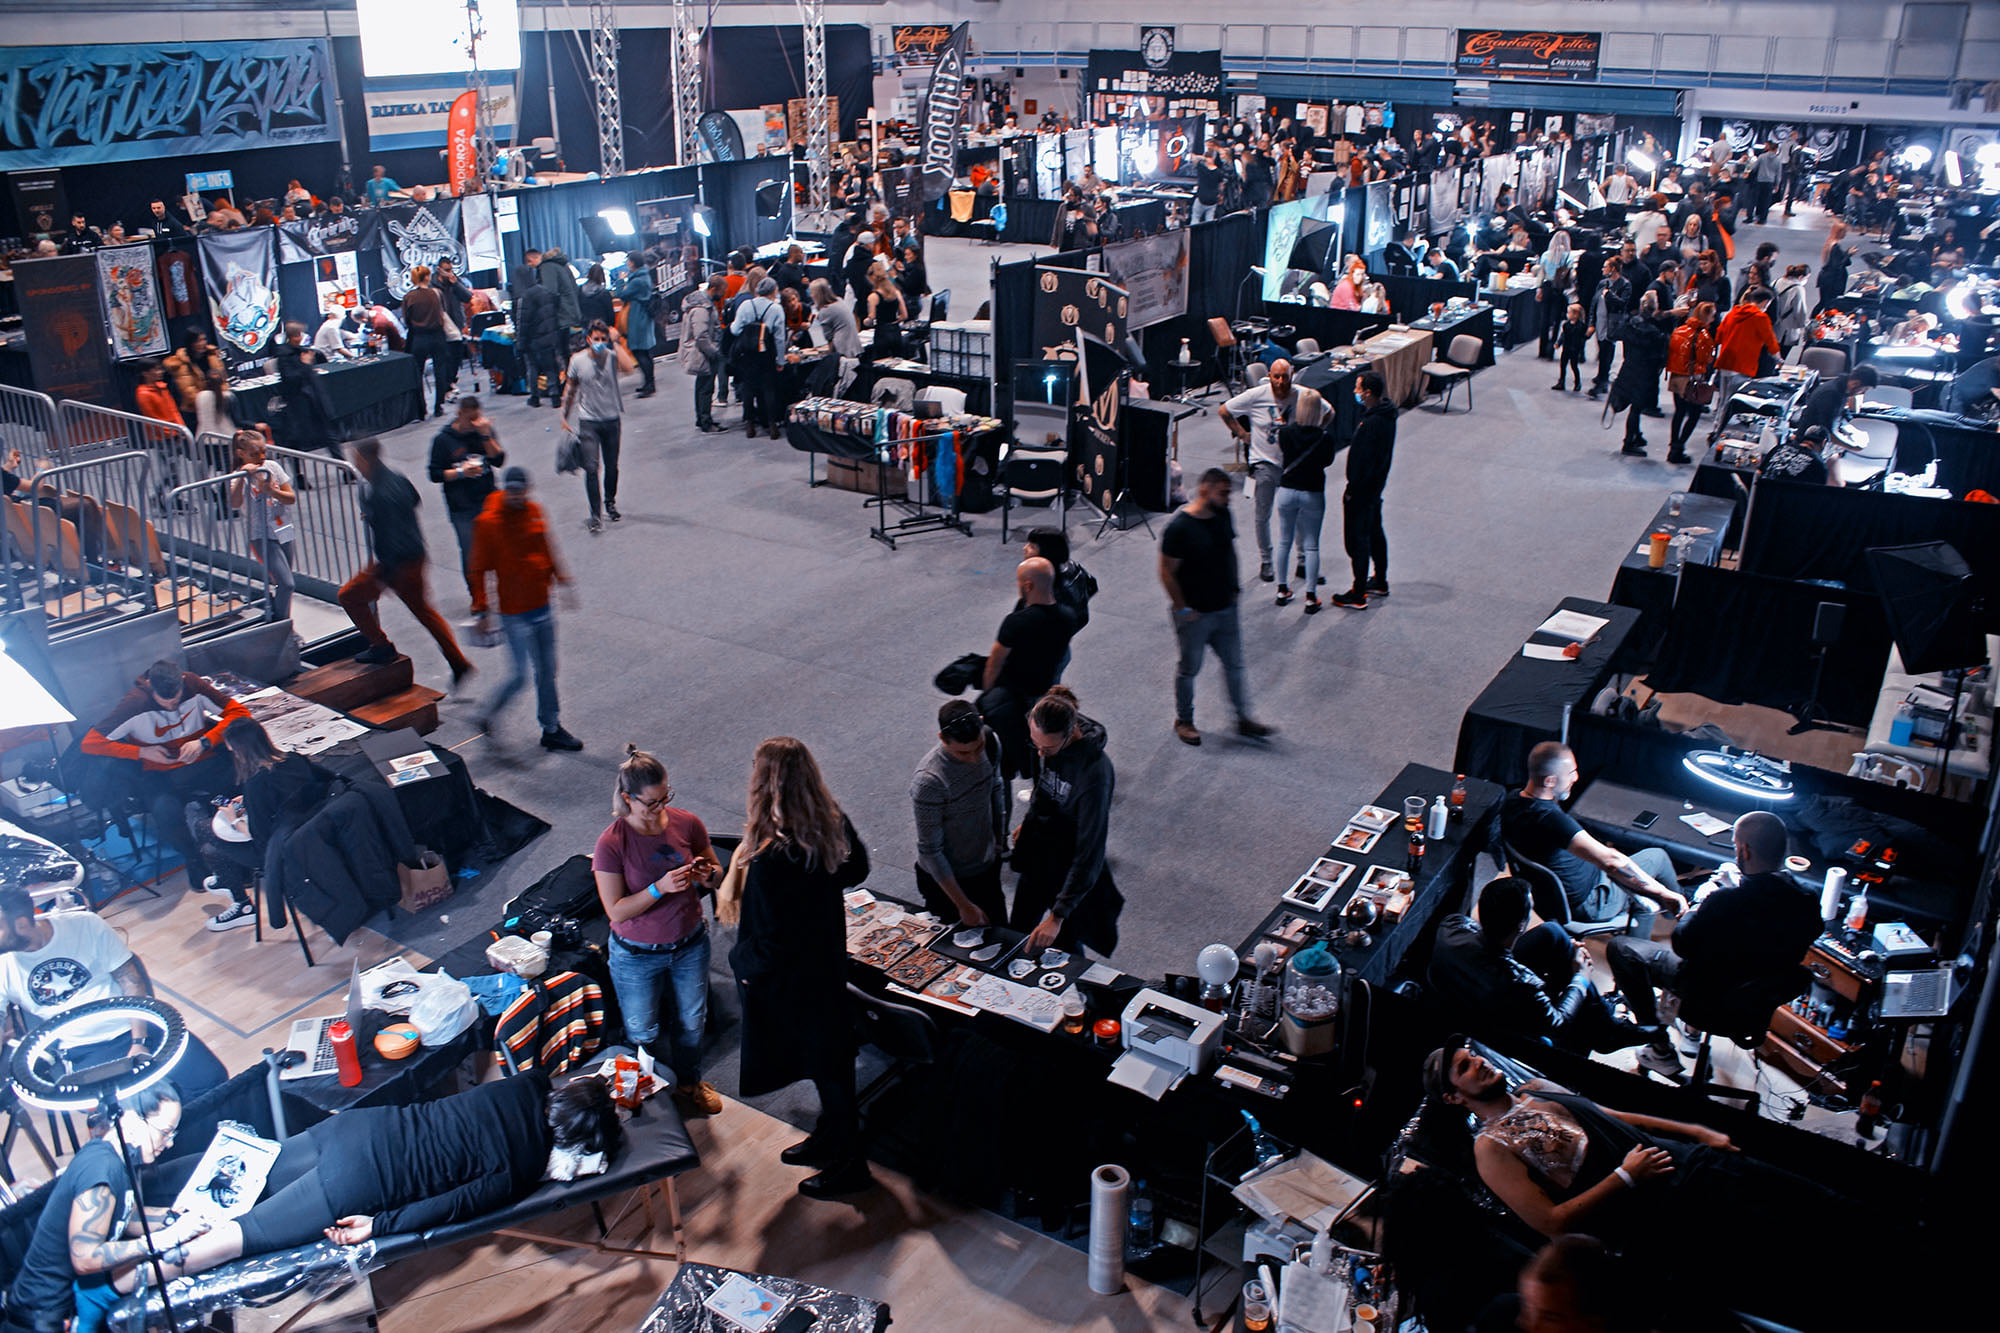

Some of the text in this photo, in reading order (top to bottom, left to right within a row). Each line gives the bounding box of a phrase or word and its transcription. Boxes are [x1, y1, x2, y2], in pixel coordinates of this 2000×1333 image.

[28, 50, 204, 148] Tattoo
[201, 45, 323, 139] Expo
[371, 103, 426, 118] RIJEKA
[207, 172, 230, 187] INFO
